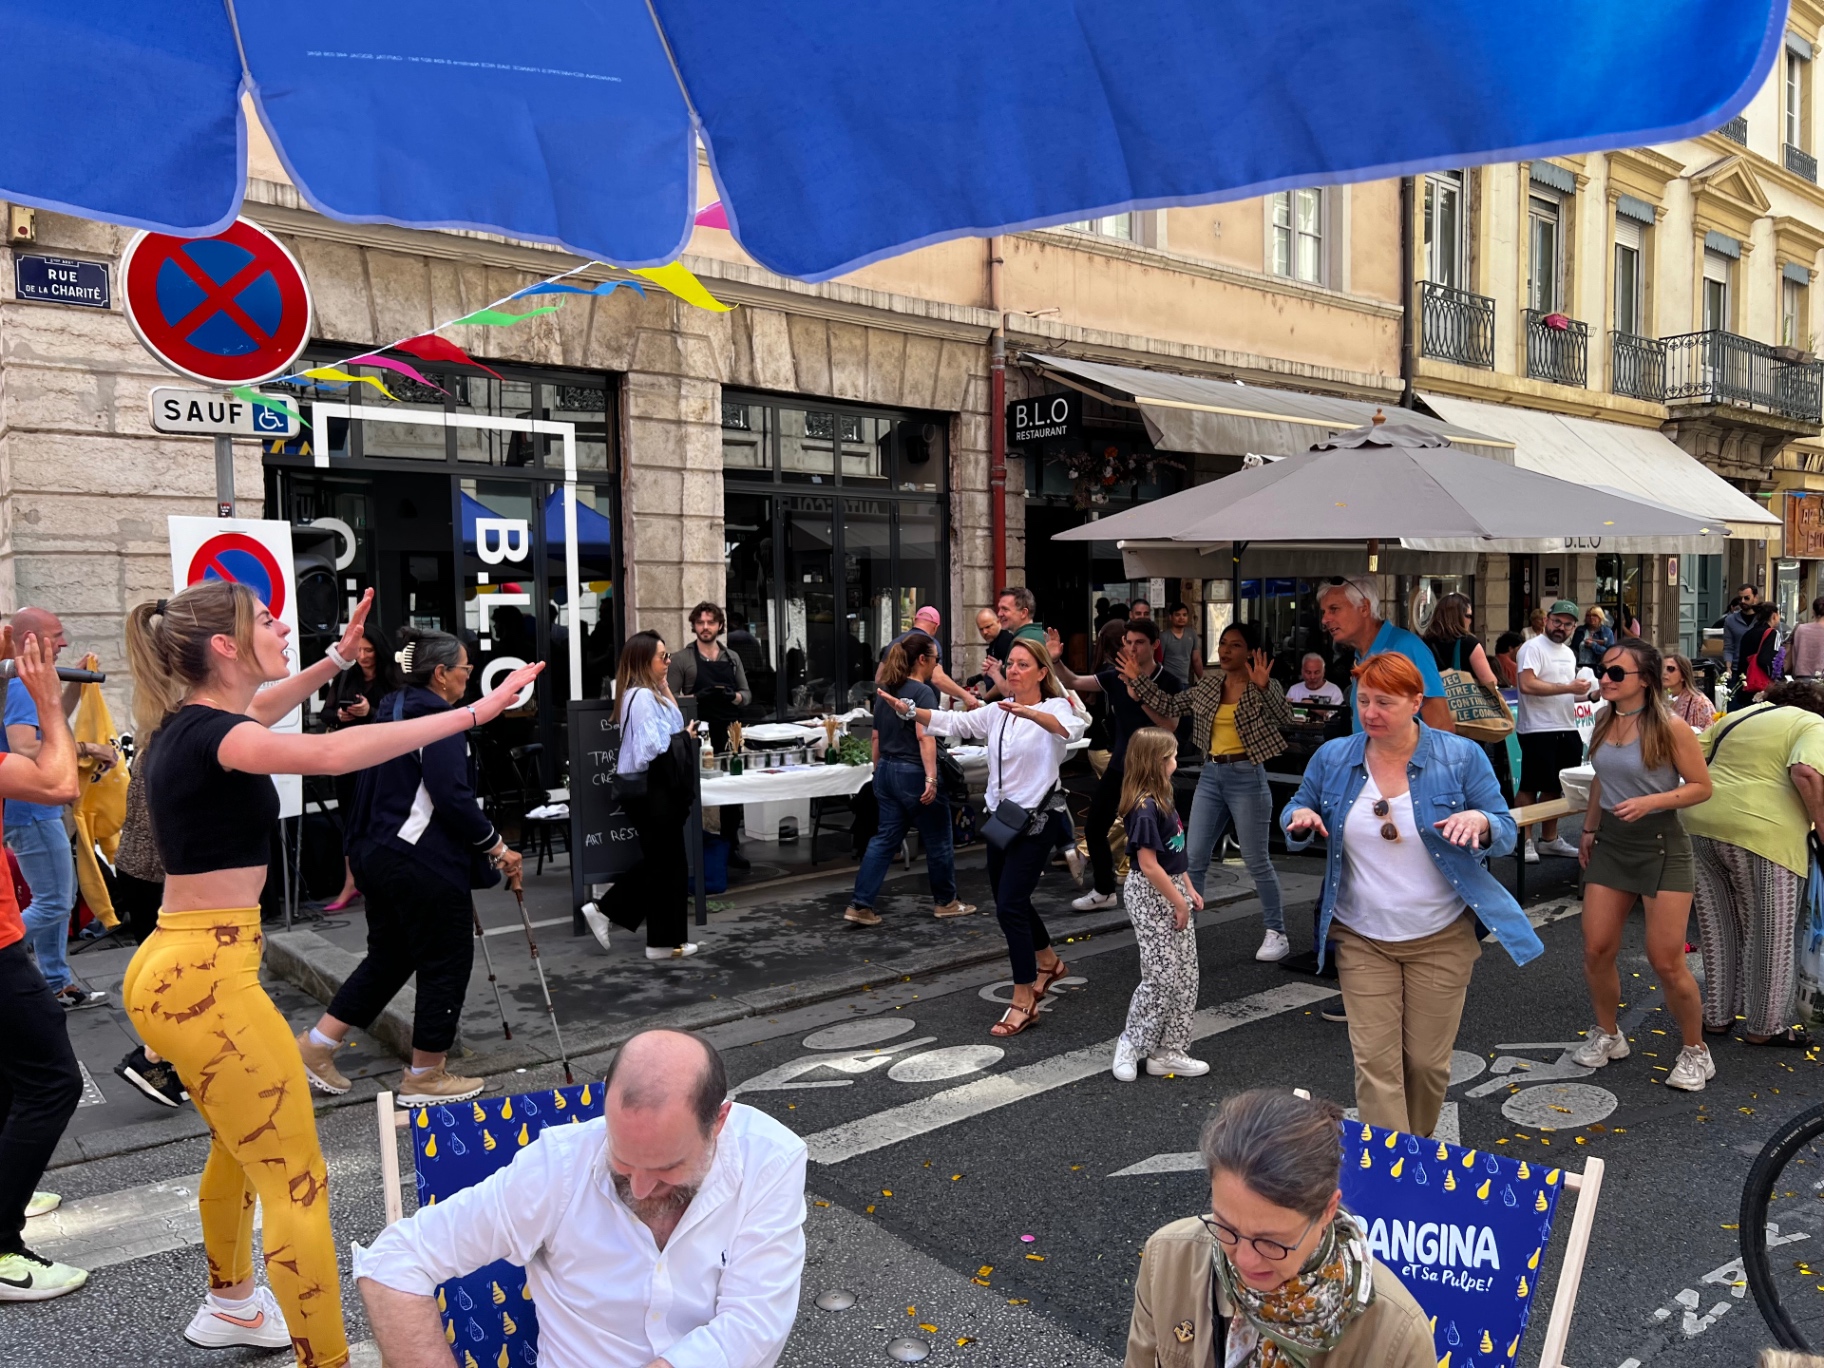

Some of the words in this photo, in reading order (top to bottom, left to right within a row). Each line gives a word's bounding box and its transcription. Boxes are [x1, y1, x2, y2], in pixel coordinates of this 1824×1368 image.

[48, 268, 78, 283] RUE
[25, 284, 35, 293] DE
[38, 286, 49, 294] LA
[51, 284, 102, 300] CHARITÉ
[163, 399, 243, 424] SAUF
[1016, 398, 1068, 428] B.L.O
[1016, 425, 1068, 441] RESTAURANT
[1446, 685, 1470, 697] OTRE
[587, 748, 619, 767] TAR
[610, 827, 640, 842] RES
[1353, 1215, 1501, 1270] ANGINA
